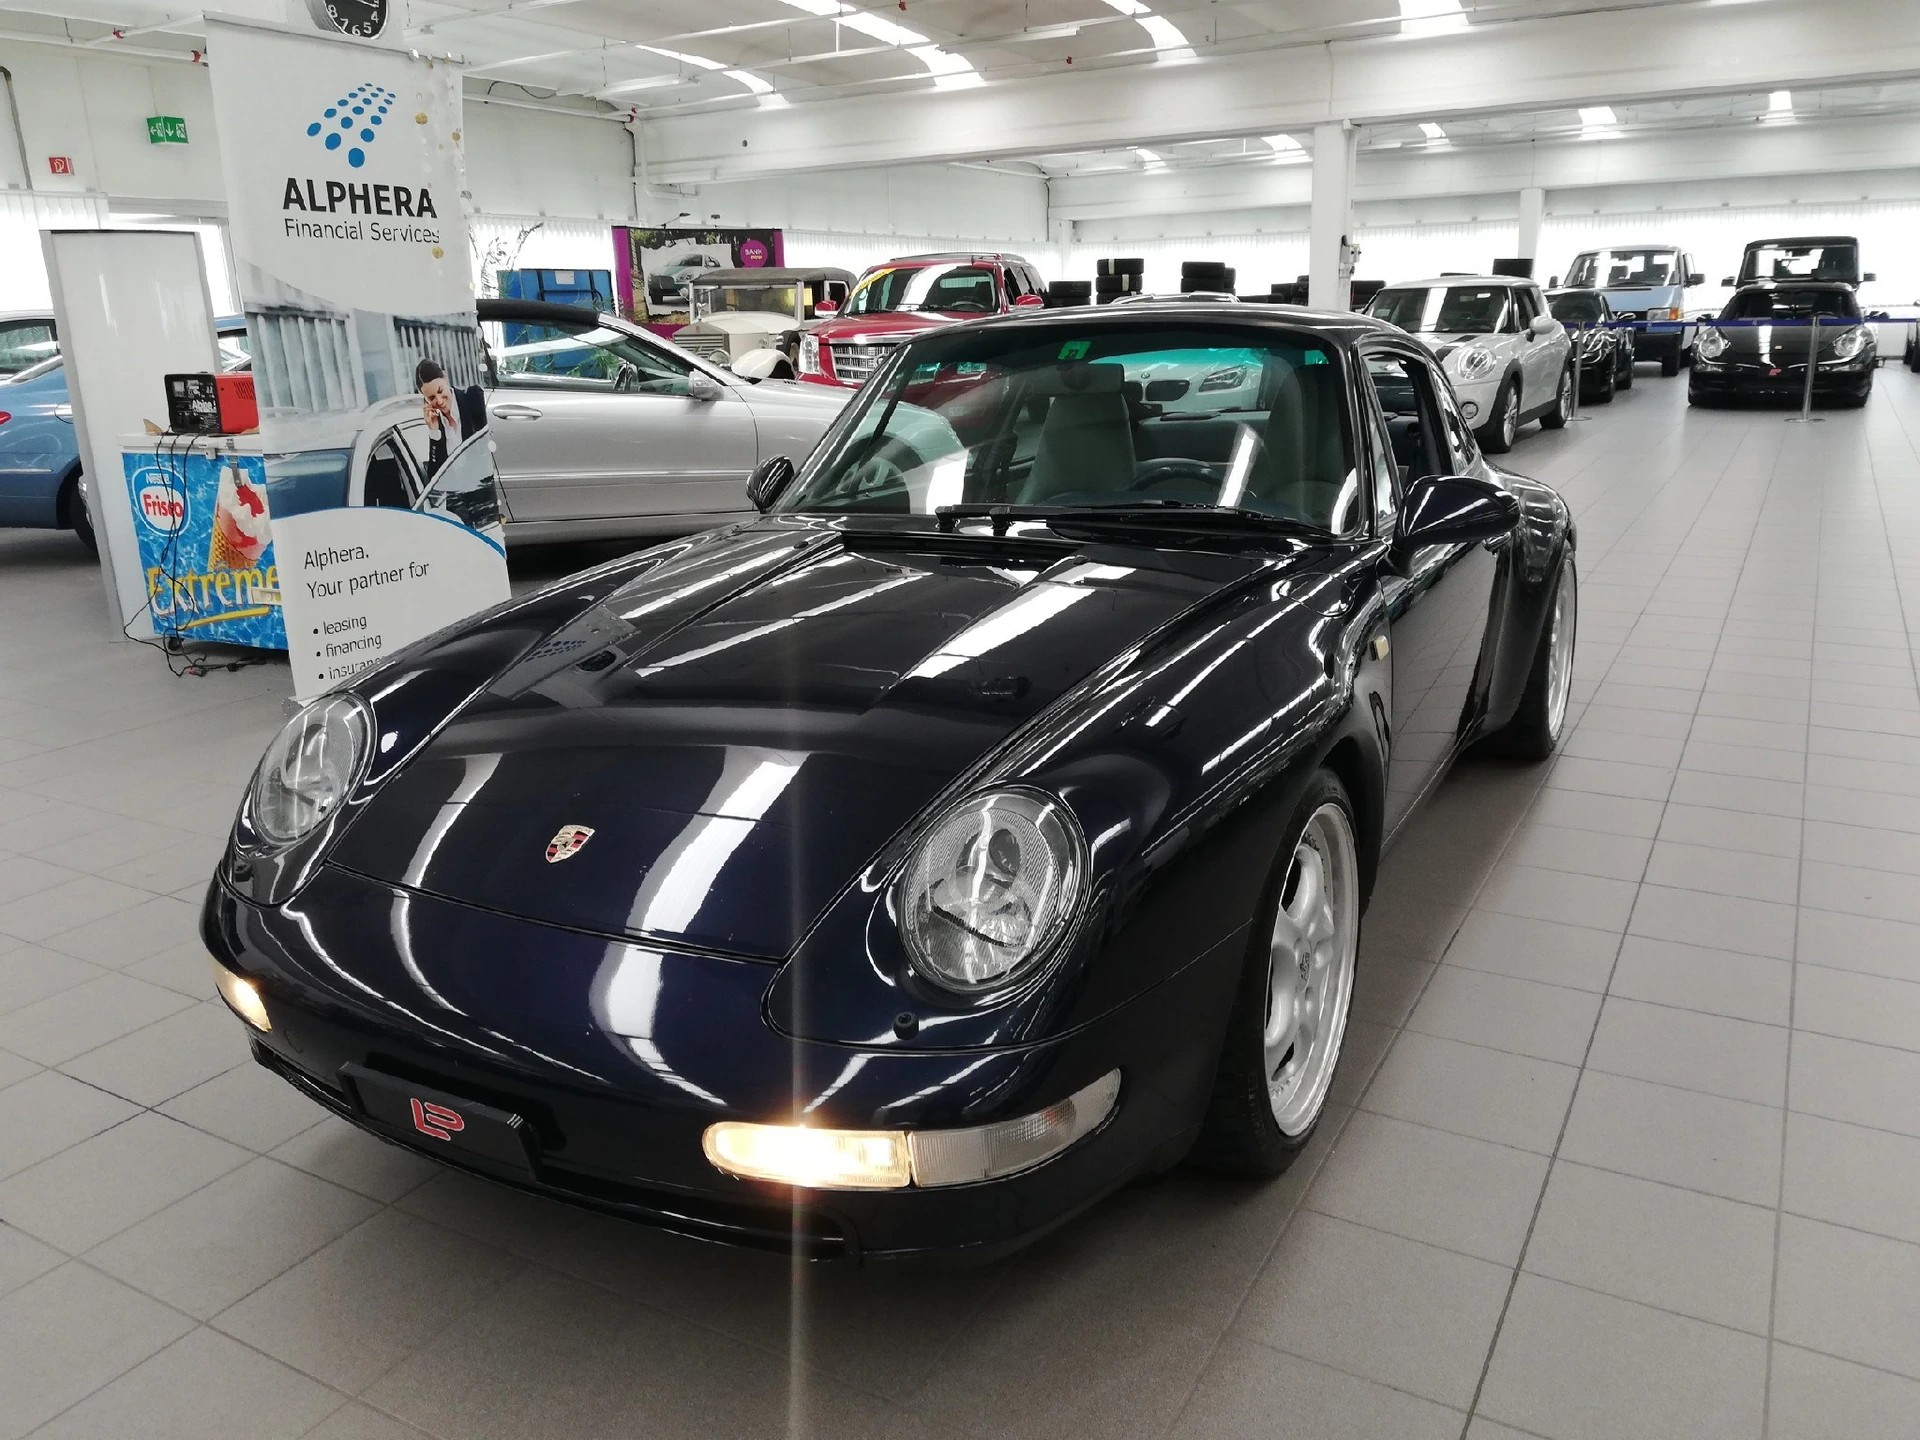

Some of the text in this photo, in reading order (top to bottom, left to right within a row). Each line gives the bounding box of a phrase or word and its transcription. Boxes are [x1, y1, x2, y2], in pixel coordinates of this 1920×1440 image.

[328, 4, 338, 18] 8
[370, 10, 379, 24] 4
[340, 18, 349, 31] 7
[351, 24, 361, 36] 6
[363, 21, 372, 34] 5
[283, 177, 438, 219] ALPHERA
[284, 218, 440, 243] Financial Services
[744, 248, 763, 256] BANK
[143, 493, 184, 518] Frisco
[303, 545, 370, 571] Alphera.
[306, 561, 430, 599] Your partner for
[322, 616, 367, 635] leasing
[325, 634, 382, 657] financing
